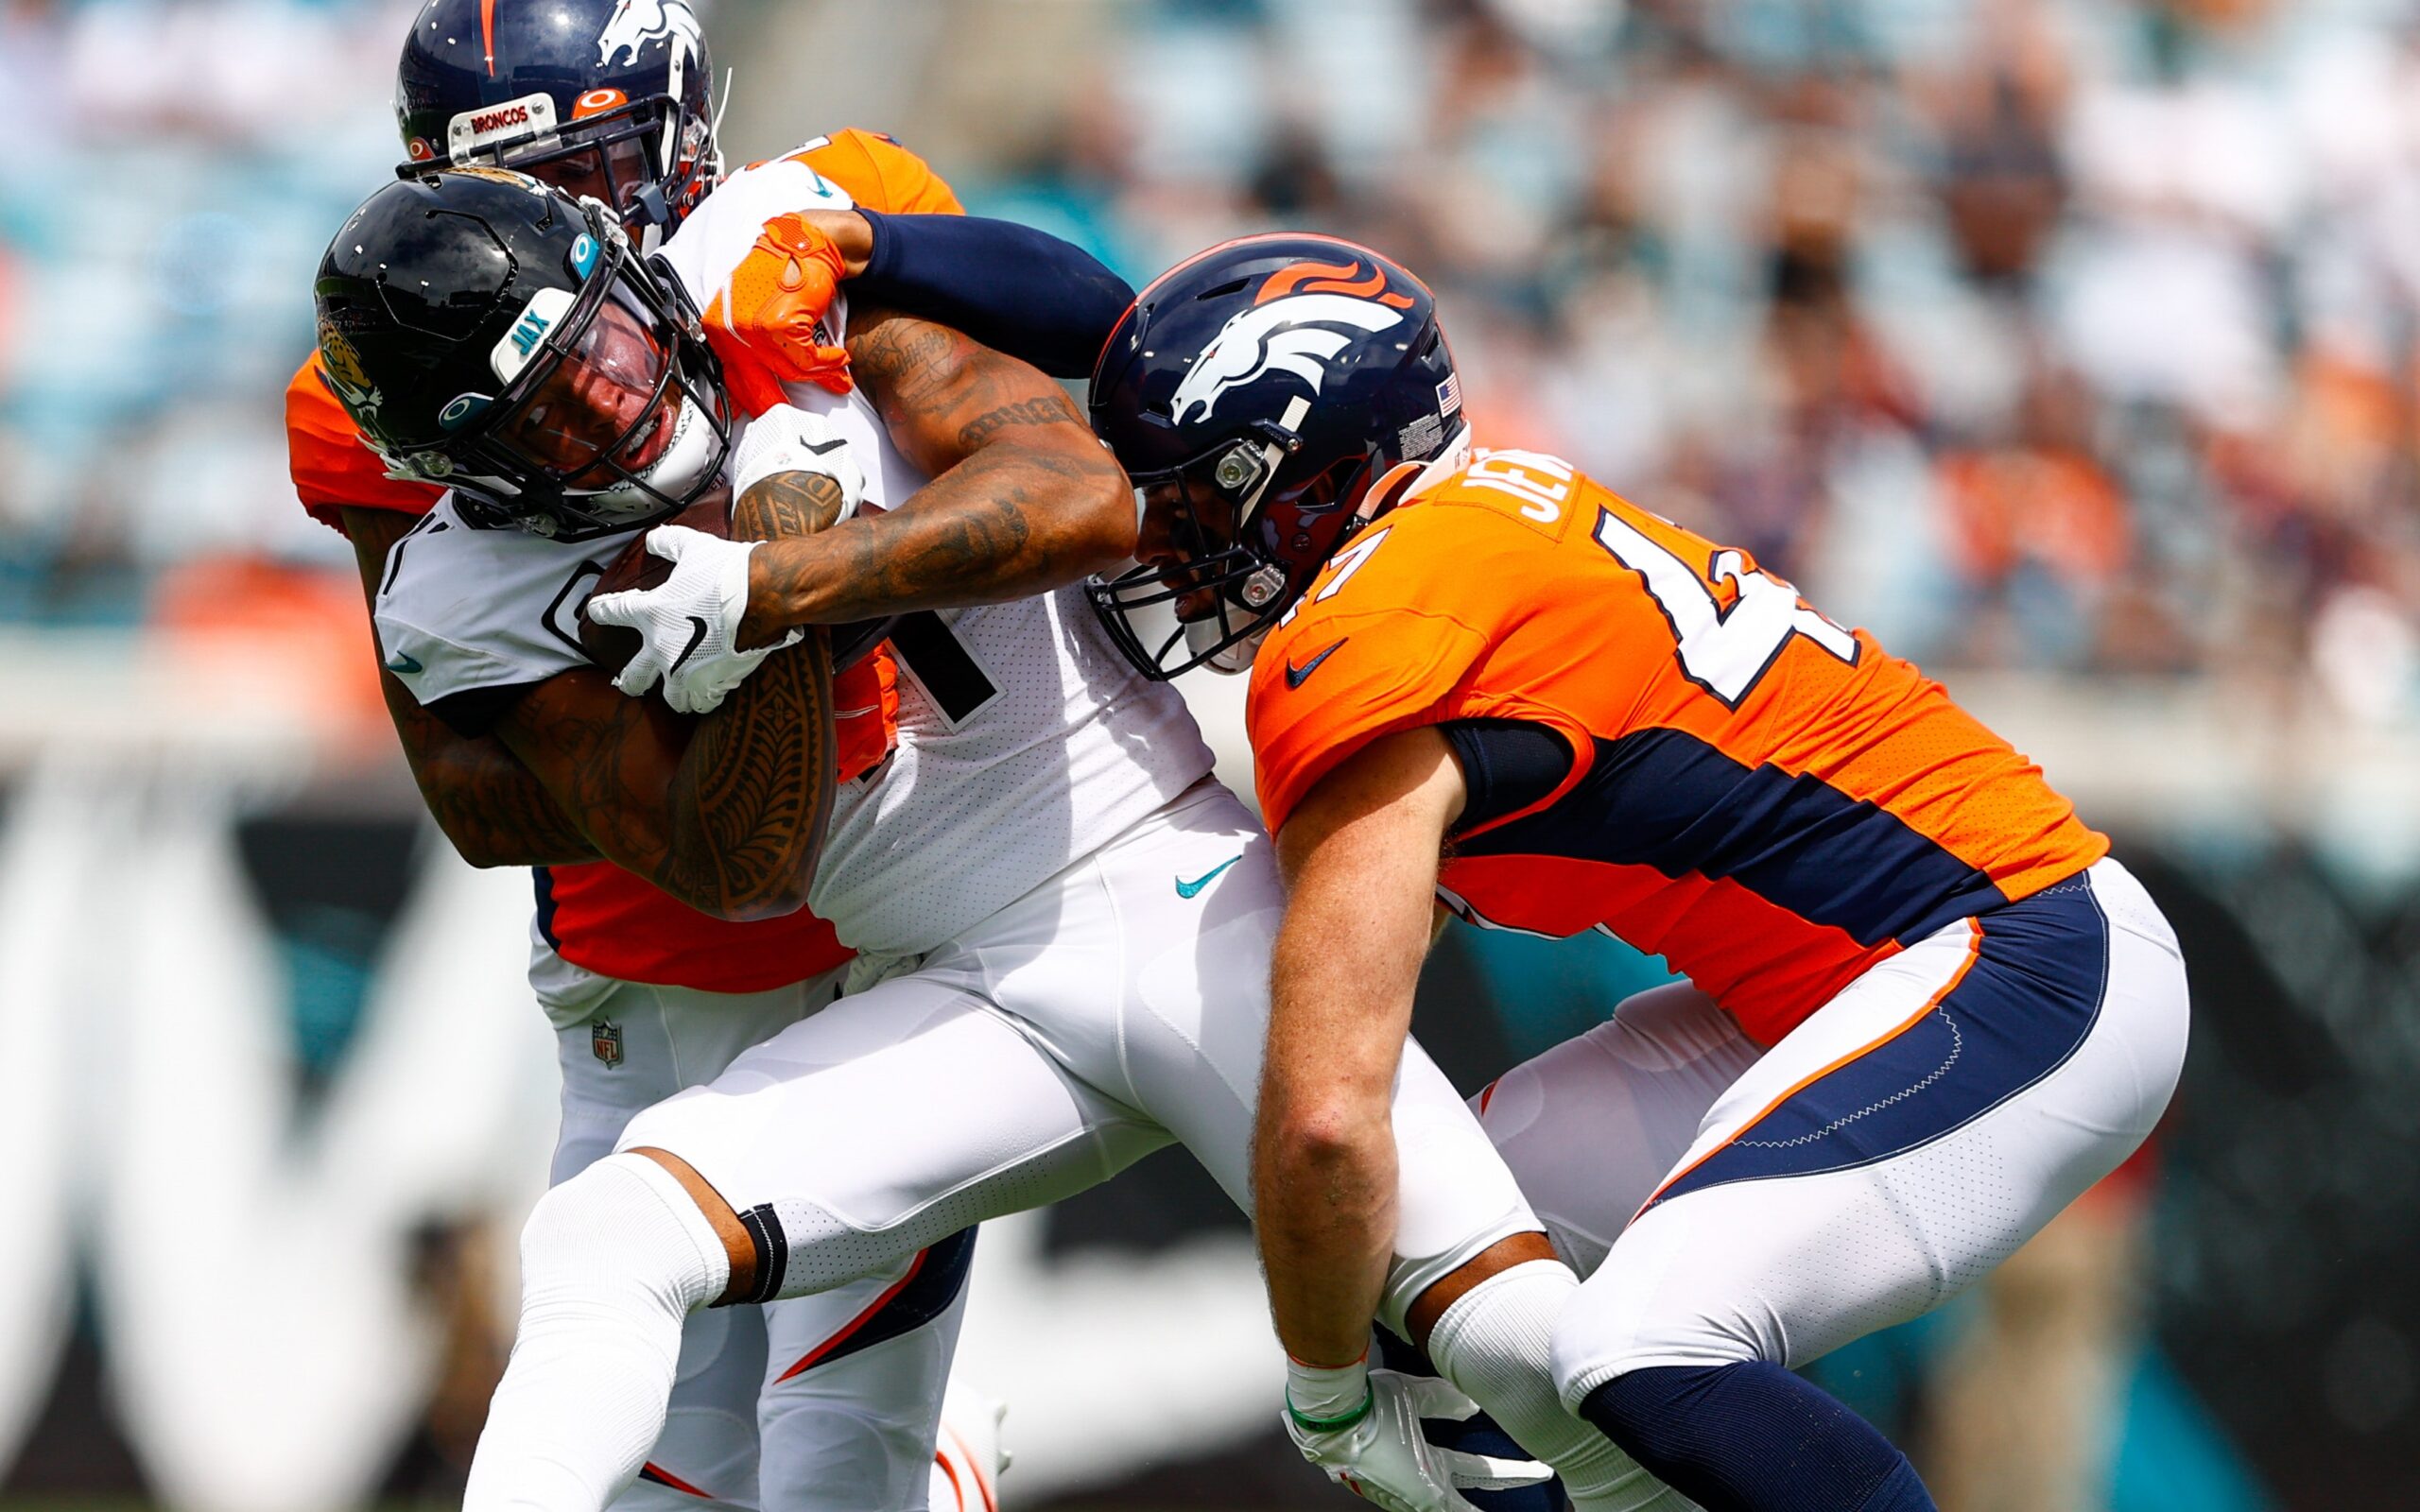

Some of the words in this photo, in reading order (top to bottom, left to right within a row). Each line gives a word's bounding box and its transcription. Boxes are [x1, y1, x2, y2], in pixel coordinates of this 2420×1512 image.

[470, 105, 528, 134] BRONCOS
[510, 308, 550, 356] JAX
[1589, 503, 1861, 713] 4
[596, 1040, 617, 1060] NFL
